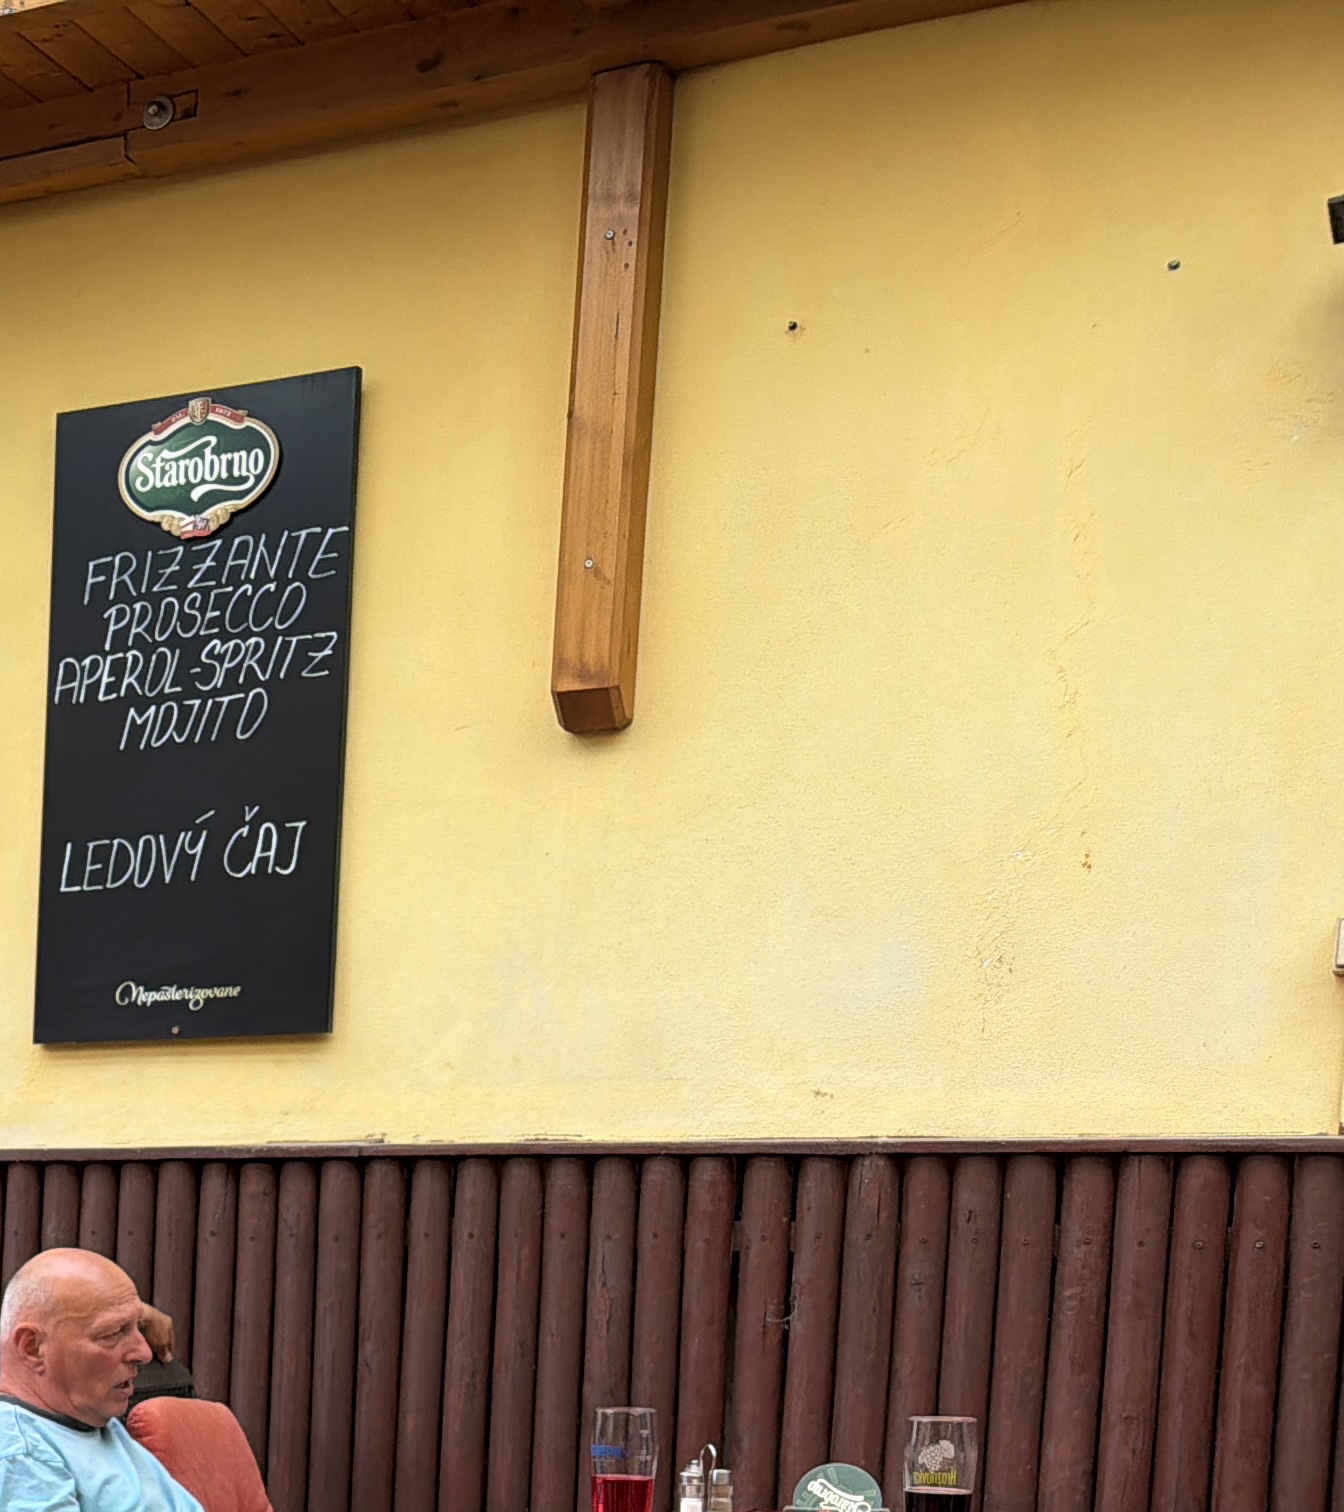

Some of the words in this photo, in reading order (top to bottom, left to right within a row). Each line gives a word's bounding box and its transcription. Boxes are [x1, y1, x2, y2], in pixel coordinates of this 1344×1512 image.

[135, 435, 264, 502] Starobrno
[83, 526, 350, 605] FRIZZANTE
[103, 582, 308, 651] PROSECCO
[119, 688, 269, 751] MOJITO
[59, 809, 216, 893] LEDOVÝ
[223, 805, 308, 878] ČAJ
